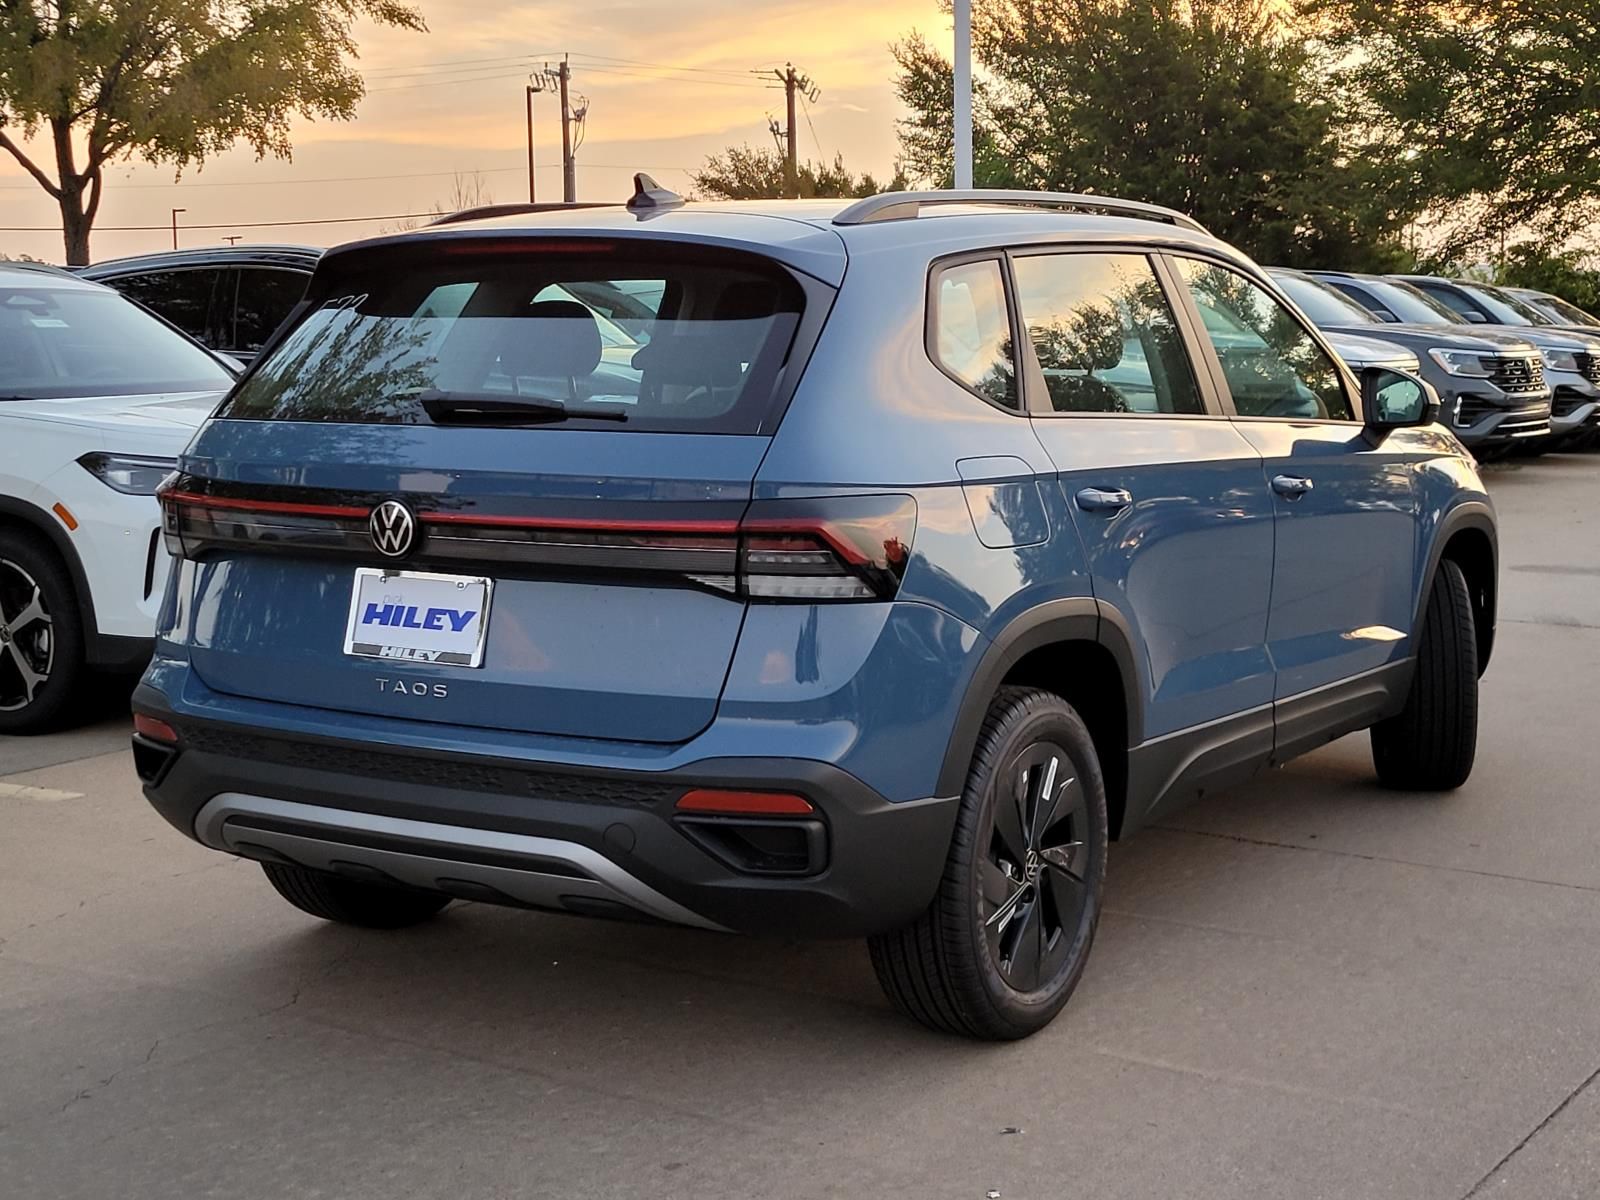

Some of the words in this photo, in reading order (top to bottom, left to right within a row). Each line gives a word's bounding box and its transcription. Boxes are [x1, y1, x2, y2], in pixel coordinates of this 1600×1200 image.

[362, 603, 477, 632] HILEY
[379, 646, 443, 662] HILEY
[375, 678, 449, 698] TAOS
